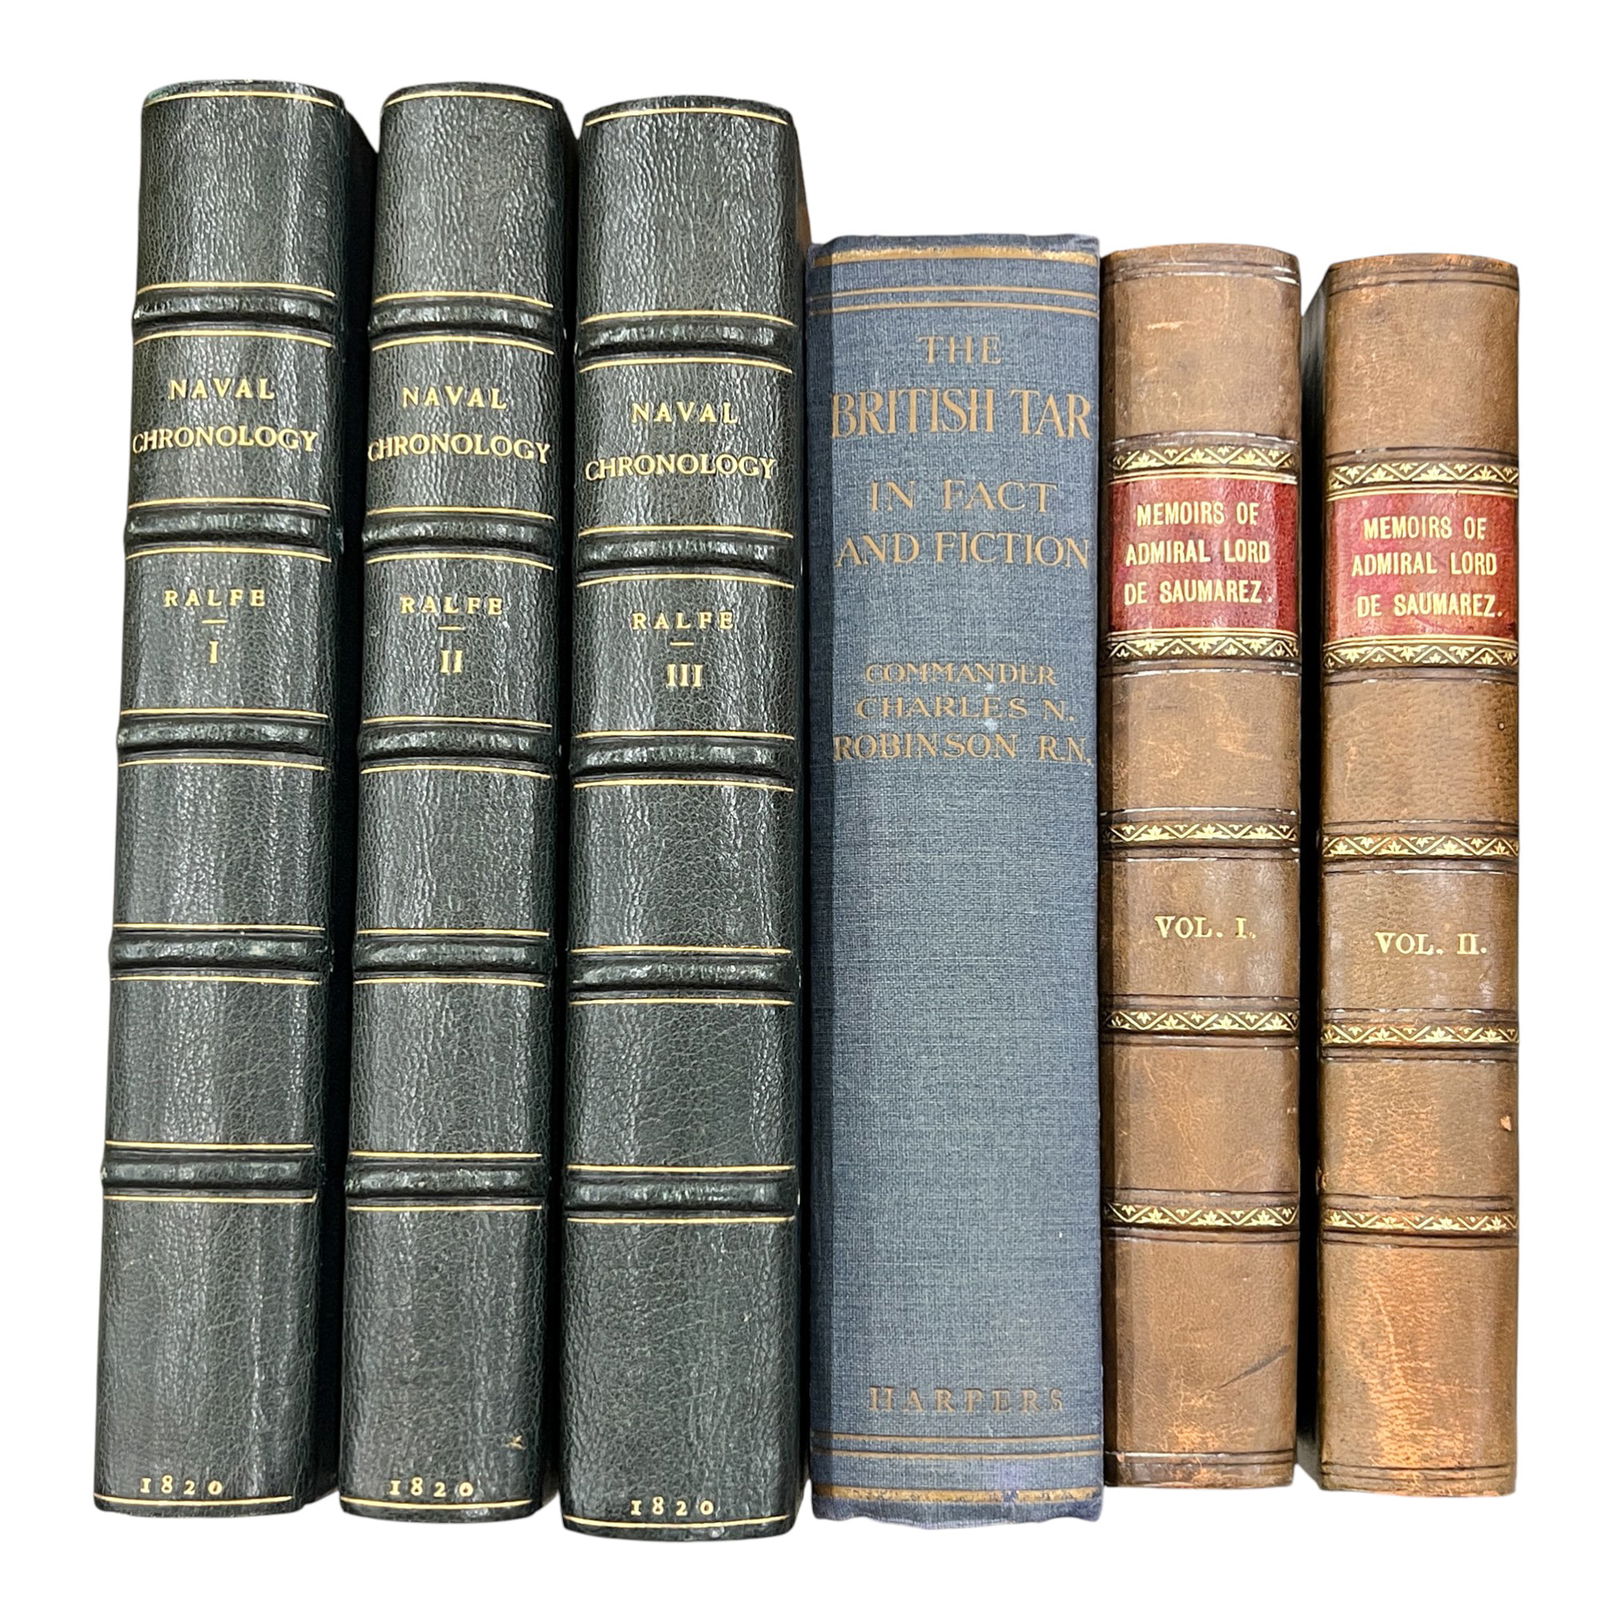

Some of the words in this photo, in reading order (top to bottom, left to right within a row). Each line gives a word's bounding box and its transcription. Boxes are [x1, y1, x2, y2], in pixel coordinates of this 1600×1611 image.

[917, 335, 1002, 365] THE
[167, 377, 275, 400] NAVAL
[401, 386, 508, 410] NAVAL
[630, 401, 739, 424] NAVAL
[830, 387, 995, 439] BRITISH
[1010, 389, 1093, 441] TAR
[132, 425, 318, 453] CHRONOLOGY
[367, 433, 551, 464] CHRONOLOGY
[585, 453, 776, 481] CHRONOLOGY
[870, 479, 917, 513] IN
[942, 479, 1057, 513] FACT
[1136, 501, 1225, 527] MEMOIRS
[1236, 501, 1260, 527] OF
[1363, 515, 1453, 541] MEMOIRS
[1463, 516, 1487, 541] OF
[834, 532, 921, 568] AND
[934, 531, 1089, 570] FICTION
[1125, 539, 1211, 566] ADMIRAL
[1223, 538, 1271, 565] LORD
[1351, 551, 1438, 577] ADMIRAL
[1450, 550, 1498, 576] LORD
[163, 589, 267, 608] RALFE
[1123, 582, 1147, 606] DE
[1159, 578, 1274, 605] SAUMAREZ.
[400, 595, 504, 616] RALFE
[1357, 594, 1382, 618] DE
[1393, 592, 1503, 619] SAUMAREZ.
[631, 611, 736, 631] RALFE
[208, 641, 219, 665] I
[440, 650, 464, 674] II
[665, 663, 704, 688] III
[865, 662, 1057, 686] COMMANDER
[856, 695, 1029, 720] CHARLES
[1043, 698, 1075, 722] N.
[833, 732, 1019, 762] ROBINSON
[1154, 915, 1224, 940] VOL.
[1374, 931, 1444, 956] VOL.
[1457, 932, 1488, 956] II.
[868, 1385, 1065, 1413] HARPERS
[139, 1475, 224, 1497] 1820
[389, 1476, 475, 1498] 1820
[630, 1495, 715, 1518] 1820
